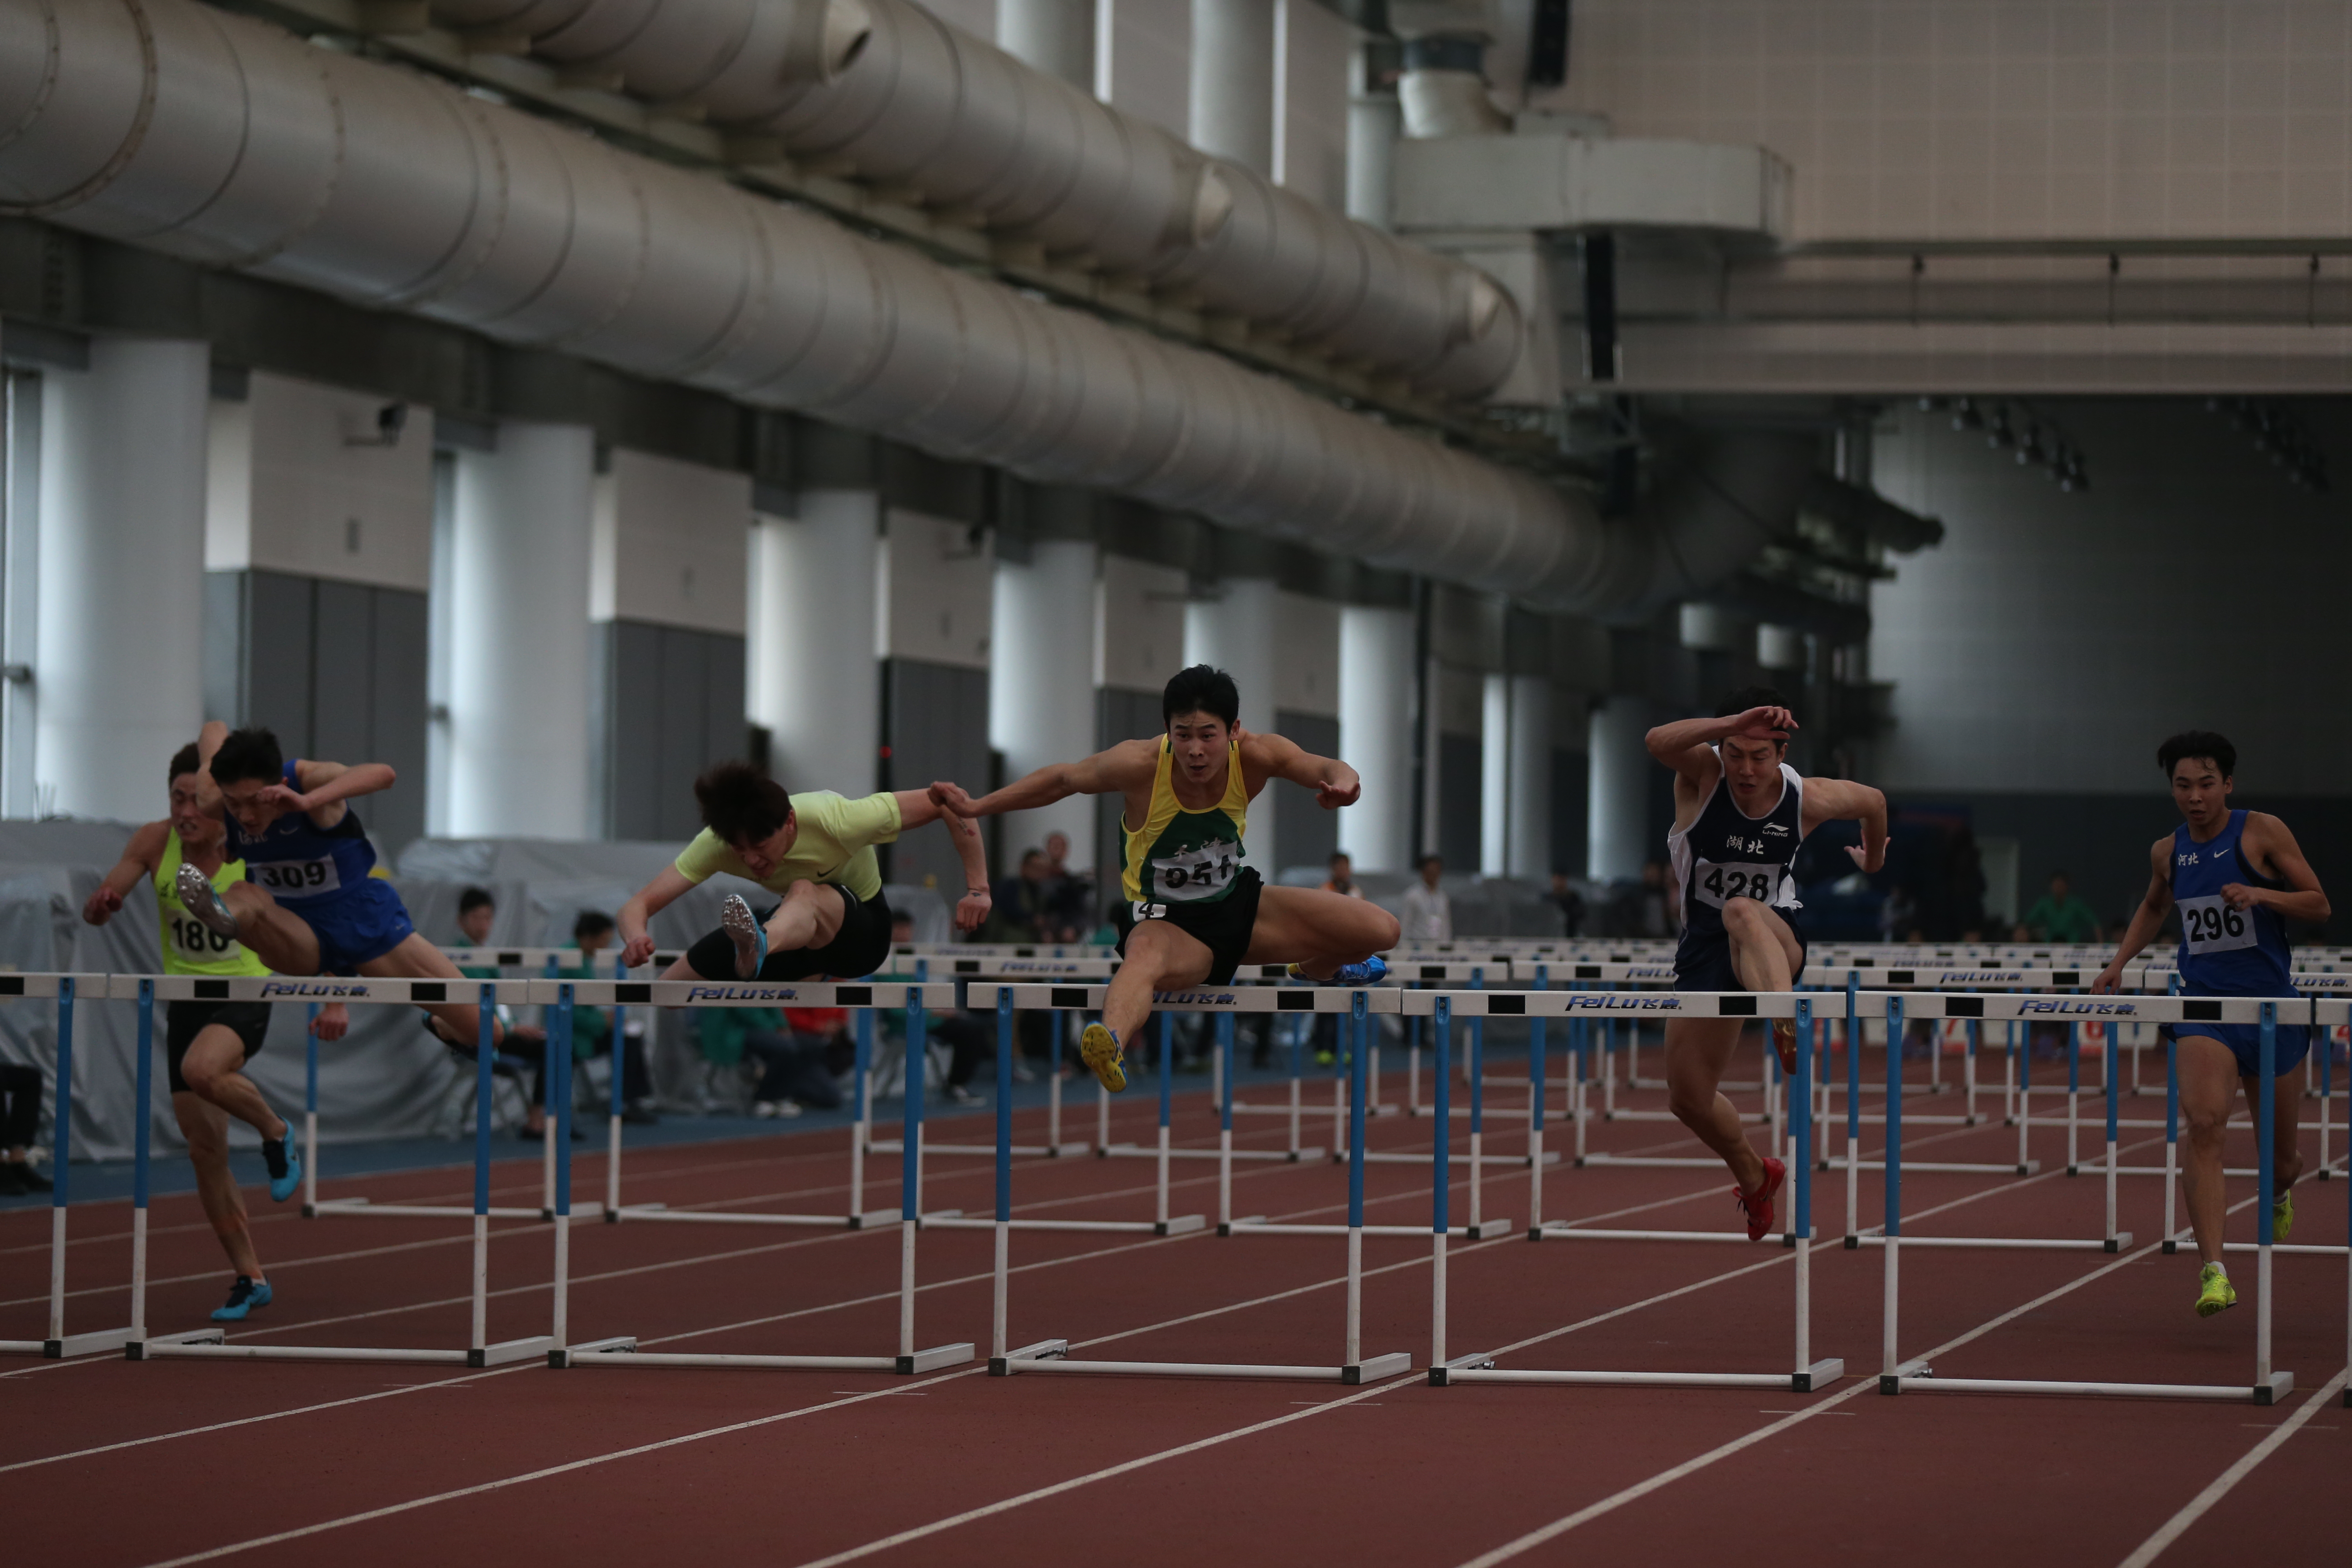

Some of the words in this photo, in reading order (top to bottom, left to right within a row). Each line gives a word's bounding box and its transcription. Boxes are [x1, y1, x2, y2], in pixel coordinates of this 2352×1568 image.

[1726, 835, 1764, 855] 湖北
[2178, 852, 2200, 867] 河北
[260, 862, 326, 888] 309
[1704, 867, 1769, 903] 428
[1138, 902, 1154, 920] 4
[2187, 904, 2244, 942] 296
